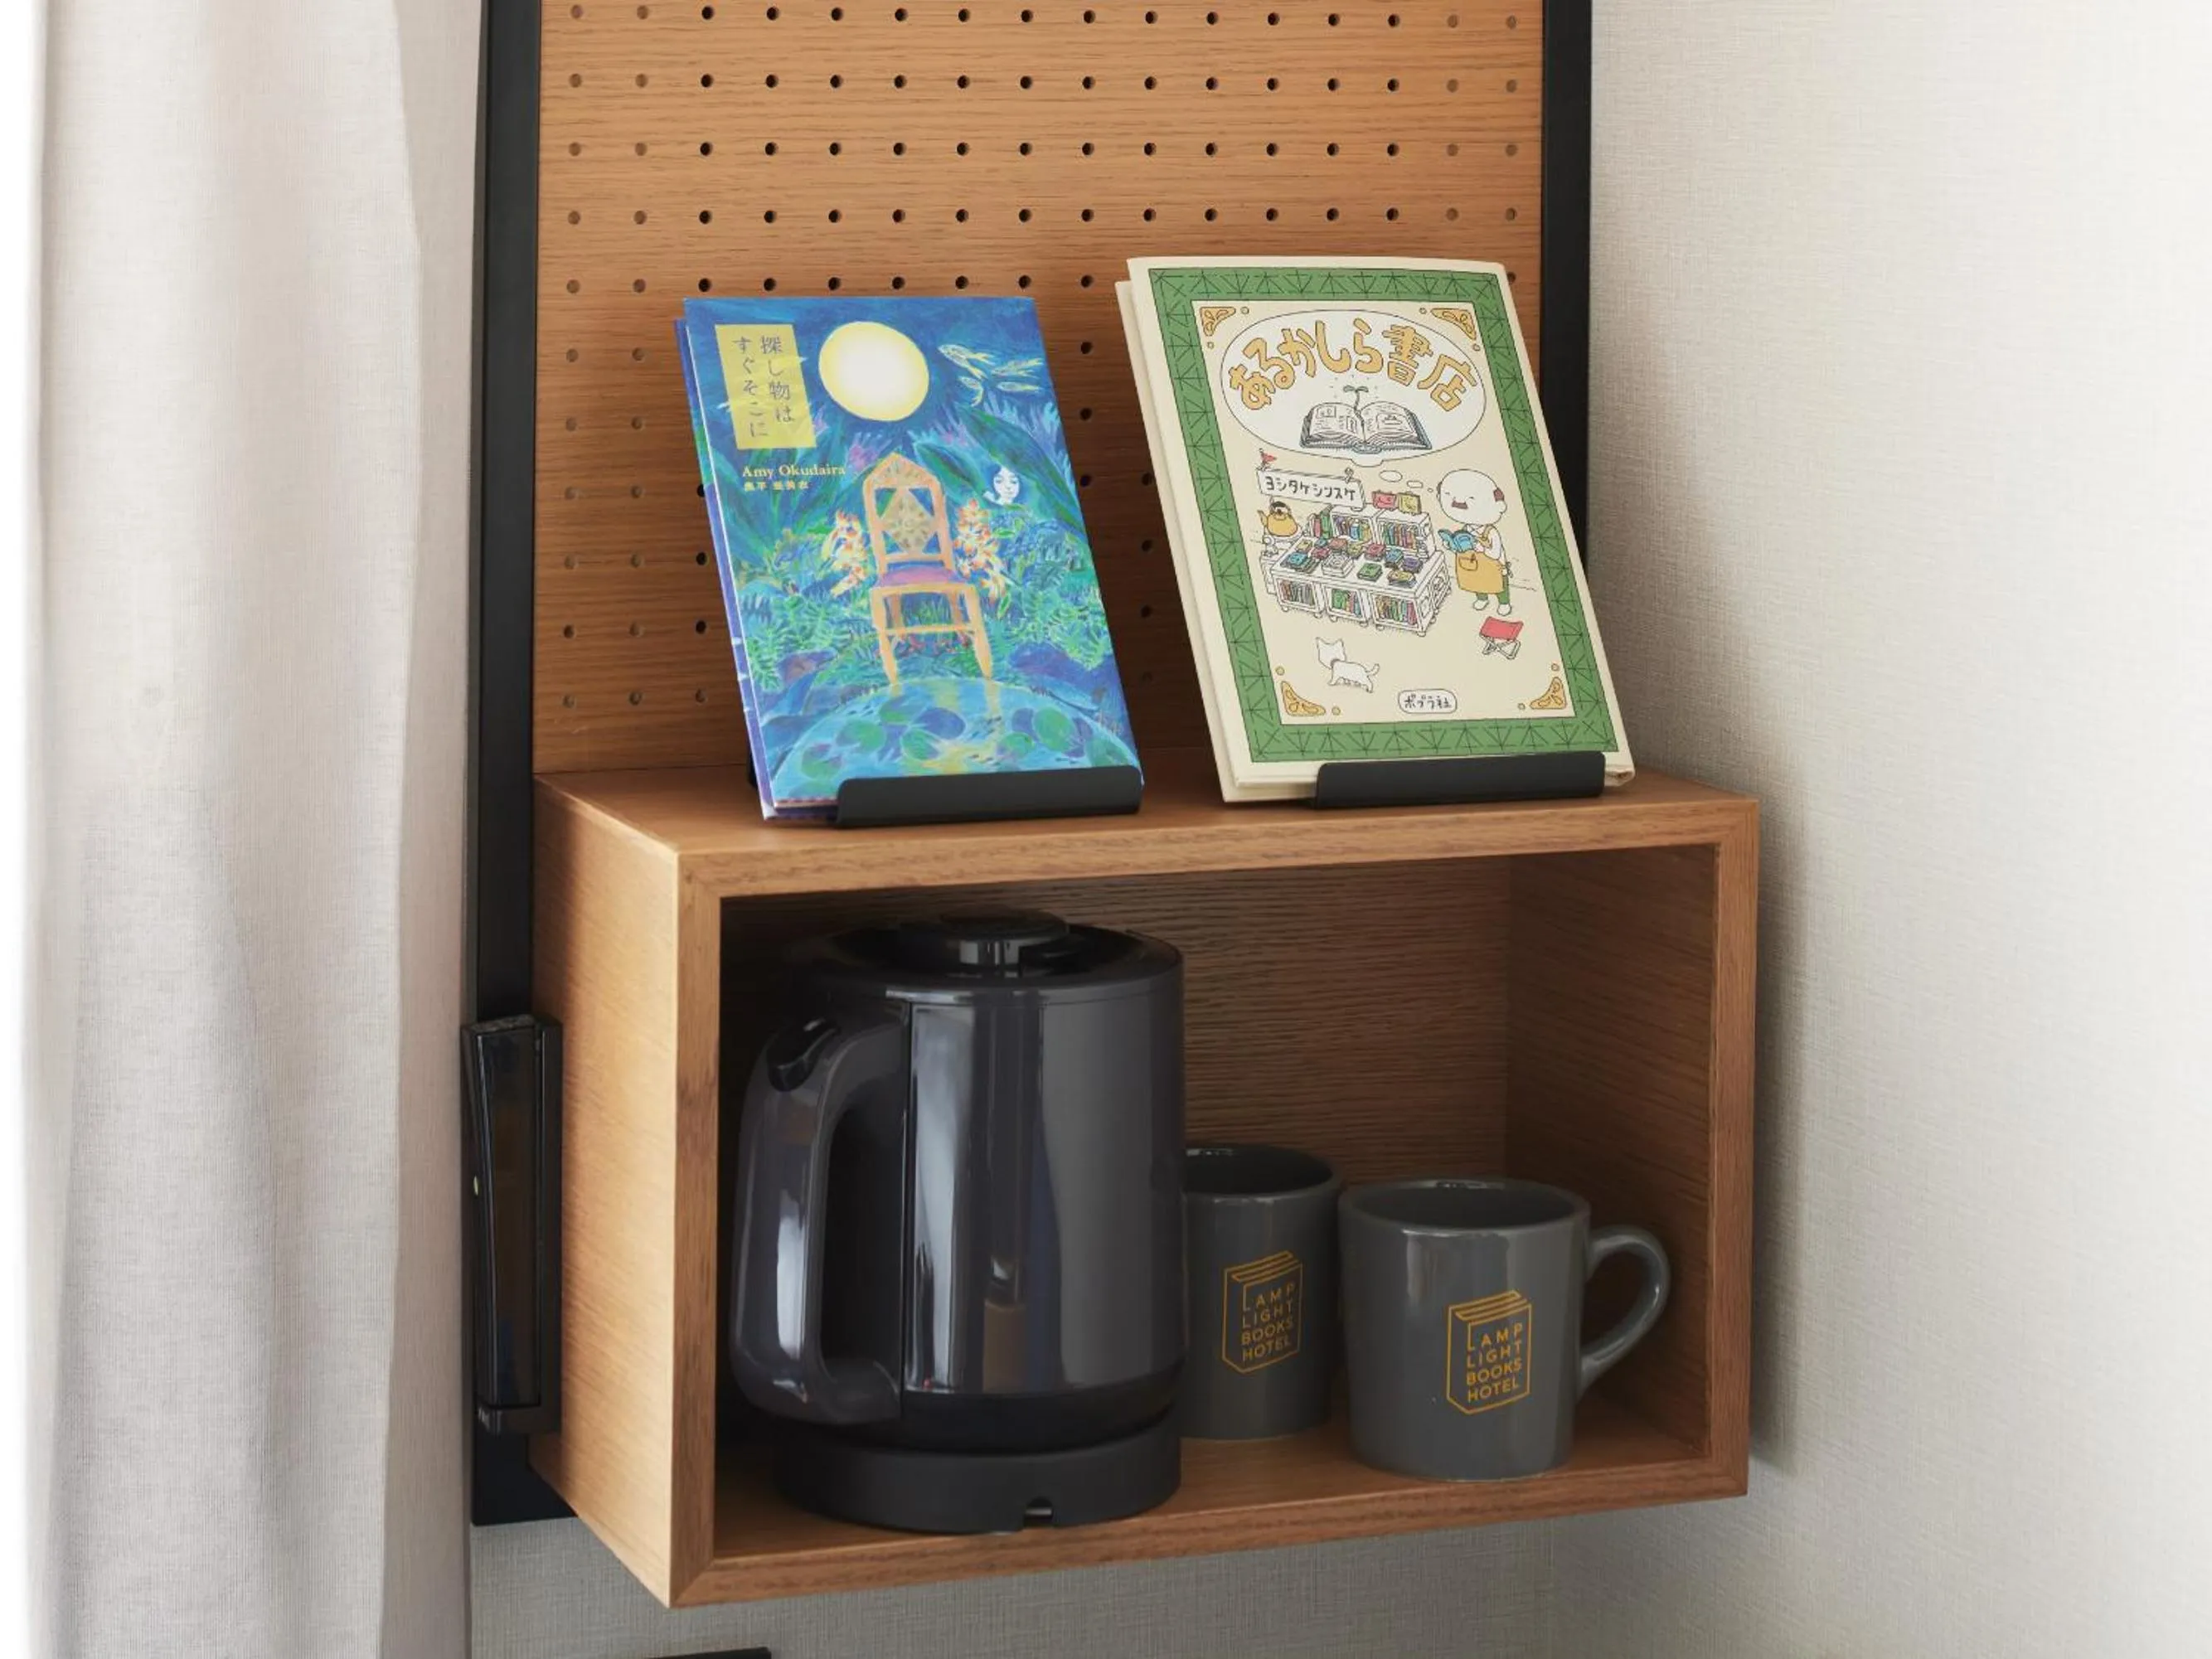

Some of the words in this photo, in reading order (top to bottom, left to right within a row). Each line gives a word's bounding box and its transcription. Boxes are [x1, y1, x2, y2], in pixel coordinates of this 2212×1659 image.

[759, 335, 795, 423] 探し物は
[1228, 318, 1477, 411] あるかしら書店
[731, 336, 769, 438] すぐそこに
[742, 465, 774, 480] Amy
[779, 463, 846, 477] Okudaira
[1264, 476, 1356, 502] ヨシタケシンスケ
[1242, 1282, 1295, 1312] LAMP
[1242, 1298, 1293, 1329] LIGHT
[1241, 1316, 1293, 1346] BOOKS
[1467, 1322, 1523, 1351] LAMP
[1242, 1334, 1291, 1362] HOTEL
[1467, 1339, 1522, 1368] LIGHT
[1466, 1357, 1522, 1386] BOOKS
[1467, 1375, 1520, 1404] HOTEL
